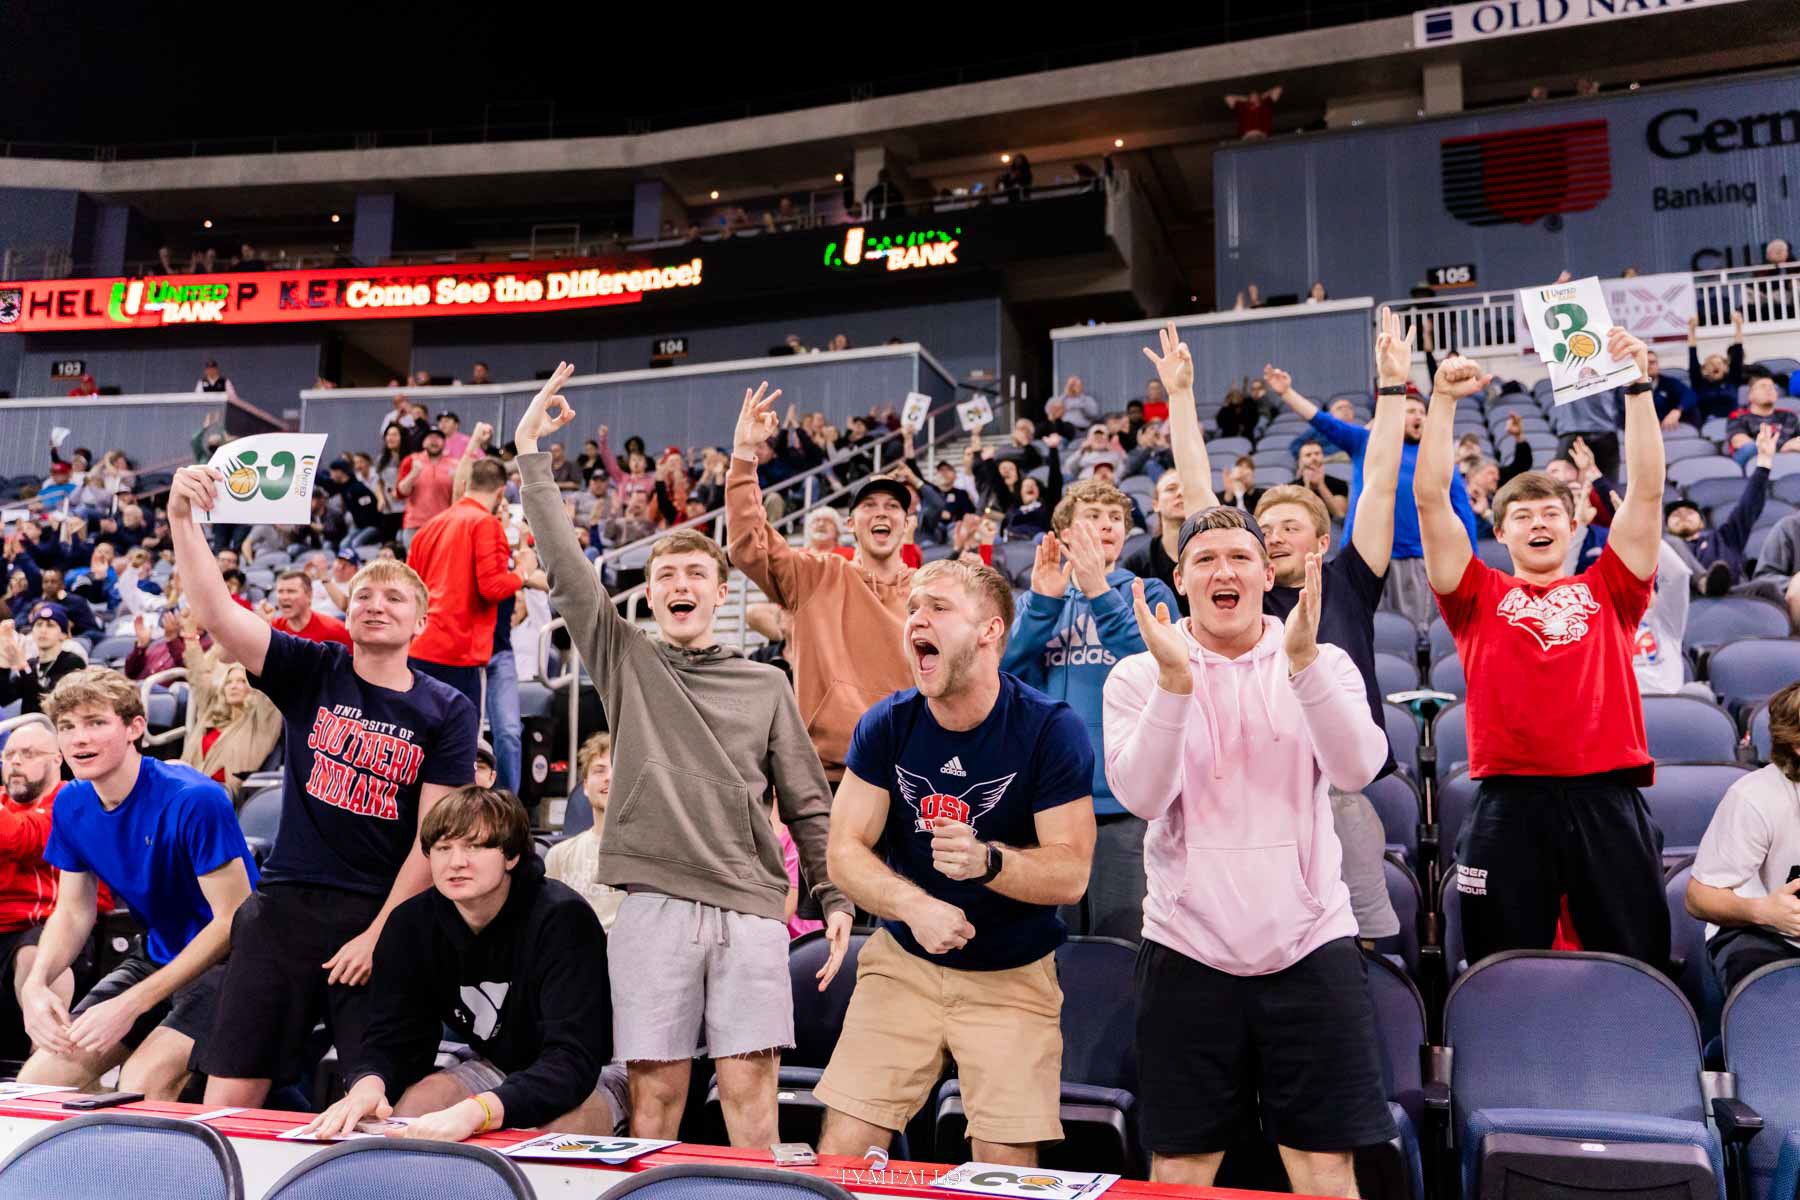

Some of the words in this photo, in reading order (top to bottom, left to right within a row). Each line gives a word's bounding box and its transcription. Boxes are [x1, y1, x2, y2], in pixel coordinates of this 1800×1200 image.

[1472, 0, 1569, 34] OLD
[1653, 180, 1758, 212] Banking
[887, 240, 959, 271] BANK
[1436, 266, 1471, 284] 105
[30, 288, 103, 318] HEL
[346, 281, 430, 308] Come
[435, 277, 490, 304] See
[494, 275, 543, 303] the
[660, 339, 683, 354] 104
[58, 362, 82, 376] 103
[333, 704, 397, 735] UNIVRSITY
[400, 728, 415, 741] OF
[308, 706, 425, 785] SOUTHERN
[306, 750, 399, 820] INDIANA
[940, 766, 967, 777] adidas
[920, 793, 970, 823] USI
